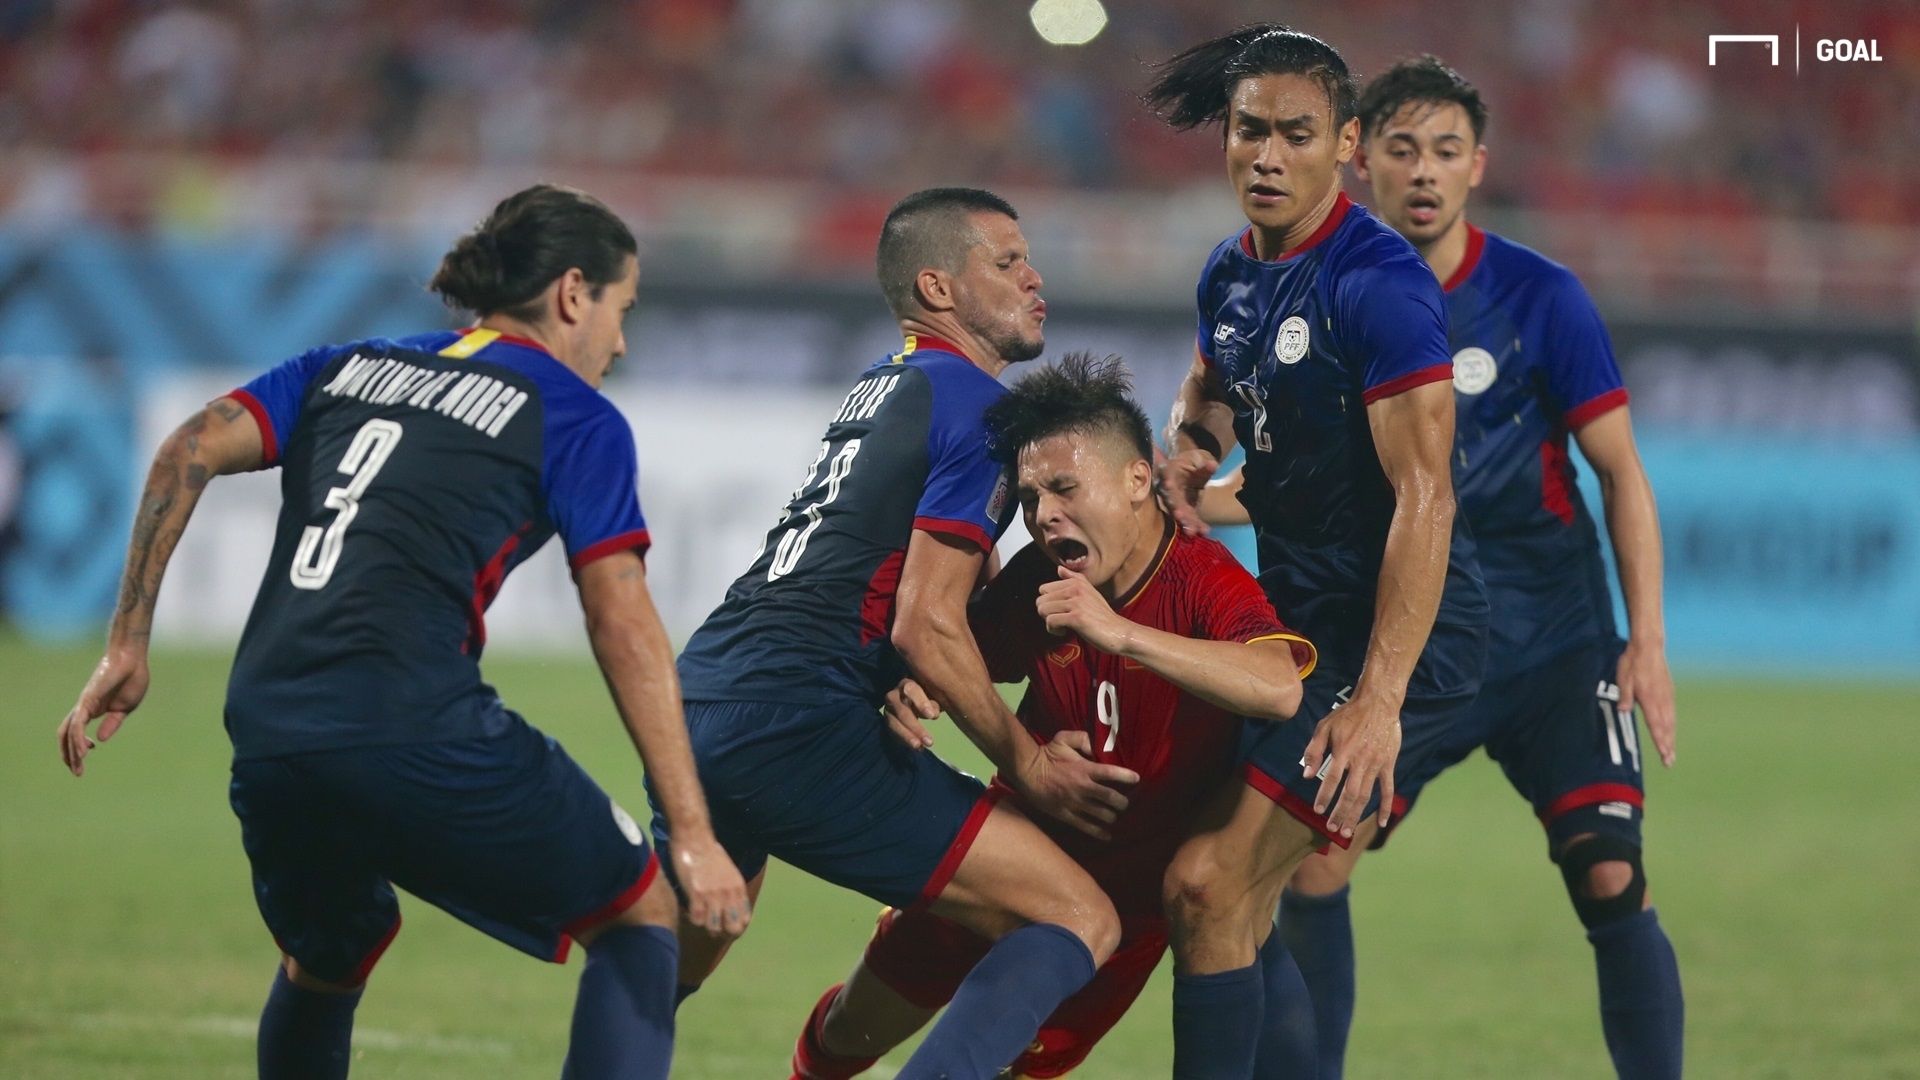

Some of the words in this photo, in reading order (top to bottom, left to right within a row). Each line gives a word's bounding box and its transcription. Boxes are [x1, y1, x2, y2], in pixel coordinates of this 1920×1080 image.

[1283, 342, 1301, 351] PFF
[434, 372, 529, 439] MURGA
[1235, 383, 1273, 453] 2
[289, 417, 404, 591] 3
[1096, 680, 1120, 753] 9
[1598, 700, 1641, 773] 14
